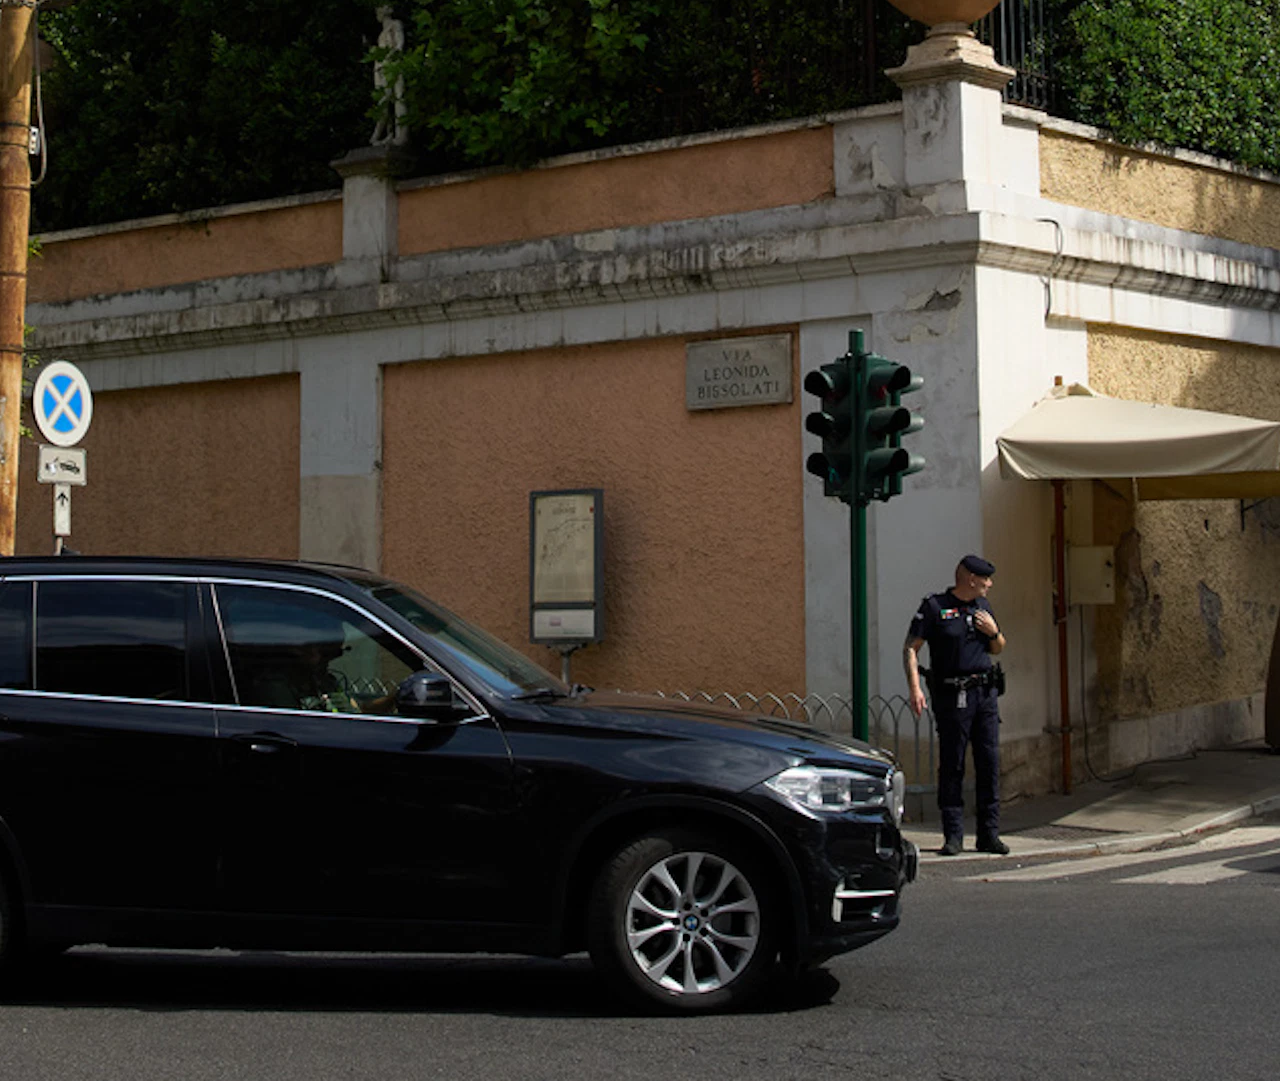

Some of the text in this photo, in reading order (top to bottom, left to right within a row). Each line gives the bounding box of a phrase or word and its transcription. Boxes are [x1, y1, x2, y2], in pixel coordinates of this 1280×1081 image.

[722, 350, 752, 362] VIA
[704, 365, 770, 382] LEONIDA
[698, 380, 779, 399] BISSOLATI
